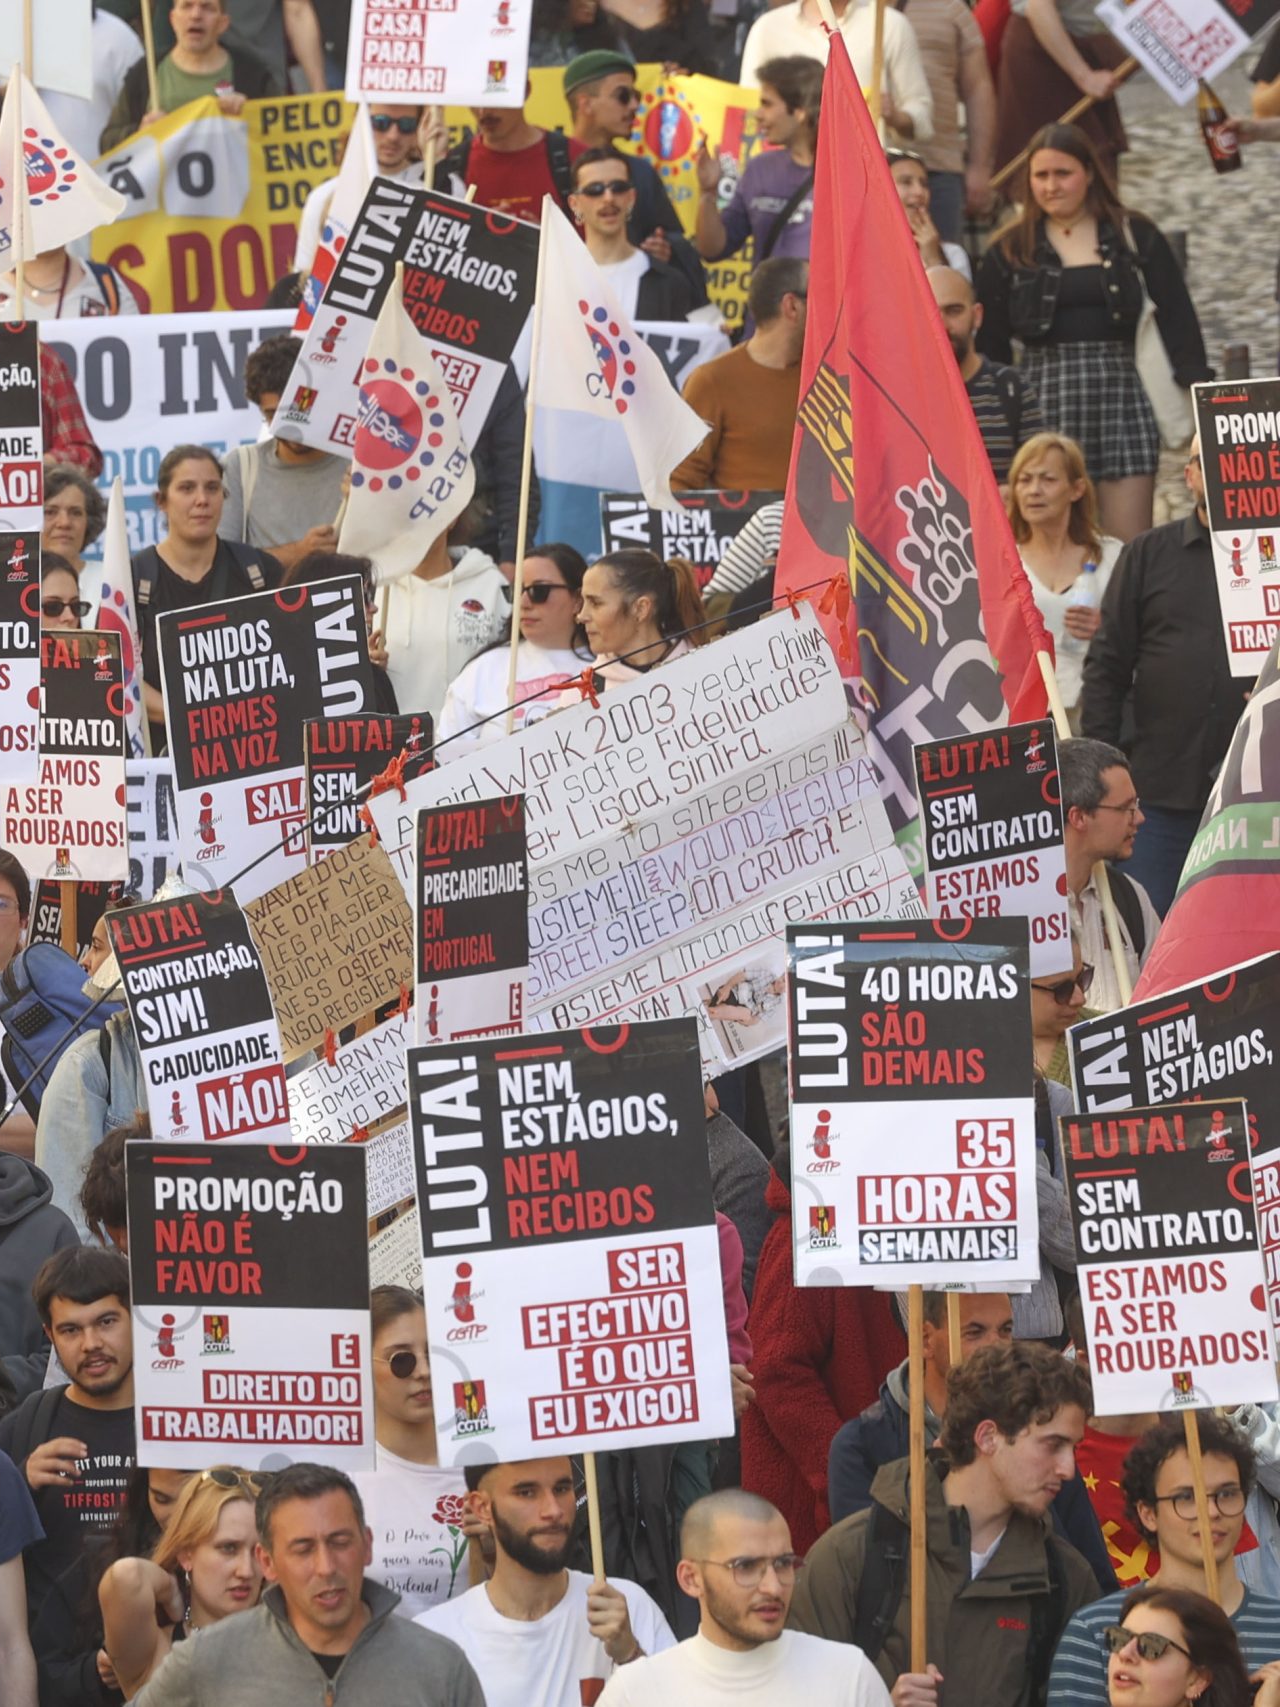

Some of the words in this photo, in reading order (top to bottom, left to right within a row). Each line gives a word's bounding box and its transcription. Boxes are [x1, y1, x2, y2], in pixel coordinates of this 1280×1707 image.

[367, 13, 423, 37] CASA
[365, 41, 420, 64] PARA
[362, 67, 443, 93] MORAR!
[261, 100, 342, 136] PELO
[330, 184, 416, 313] LUTA!
[404, 238, 519, 303] ESTÁGIOS,
[1215, 411, 1280, 445] PROM
[1220, 445, 1265, 483] NÃO
[179, 618, 272, 668] UNIDOS
[183, 668, 221, 705] NA
[225, 653, 296, 697] LUTA,
[187, 693, 278, 743] FIRMES
[311, 719, 394, 754] LUTA!
[191, 742, 229, 779] NA
[231, 730, 280, 770] VOZ
[920, 735, 1011, 783] LUTA!
[6, 788, 19, 814] A
[25, 788, 63, 814] SER
[313, 771, 357, 802] SEM
[6, 818, 125, 848] ROUBADOS!
[425, 808, 486, 855] LUTA!
[930, 793, 978, 829] SEM
[931, 810, 1060, 861] CONTRATO.
[424, 861, 524, 905] PRECARIEDADE
[935, 856, 1040, 902] ESTAMOS
[111, 902, 203, 952] LUTA!
[424, 907, 444, 938] EM
[126, 942, 258, 995] CONTRATAÇÃO,
[424, 934, 496, 973] PORTUGAL
[860, 965, 900, 1003] 40
[908, 963, 1019, 1002] HORAS
[136, 987, 209, 1043] SIM!
[795, 934, 849, 1088] LUTA!
[860, 1004, 927, 1047] SÃO
[148, 1033, 278, 1086] CADUCIDADE,
[1141, 1014, 1199, 1067] NEM
[497, 1060, 573, 1107] NEM
[862, 1048, 987, 1087] DEMAIS
[1145, 1028, 1274, 1105] ESTÁGIOS,
[203, 1073, 286, 1136] NÃO!
[500, 1092, 678, 1150] ESTÁGIOS,
[417, 1054, 493, 1249] LUTA!
[961, 1120, 1012, 1168] 35
[1068, 1114, 1187, 1161] LUTA!
[503, 1149, 580, 1196] NEM
[806, 1160, 841, 1174] CGTP
[153, 1171, 343, 1221] PROMOÇÃO
[506, 1183, 656, 1239] RECIBOS
[863, 1174, 1013, 1225] HORAS
[1077, 1178, 1141, 1216] SEM
[154, 1212, 226, 1255] NÃO
[233, 1212, 253, 1255] É
[810, 1237, 837, 1248] CGTP
[862, 1229, 1016, 1263] SEMANAIS!
[1079, 1207, 1254, 1255] CONTRATO.
[156, 1259, 262, 1295] FAVOR
[617, 1246, 682, 1289] SER
[1086, 1259, 1228, 1302] ESTAMOS
[446, 1323, 488, 1343] CGTP
[527, 1291, 687, 1345] EFECTIVO
[1093, 1306, 1115, 1338] A
[1120, 1300, 1177, 1336] SER
[337, 1336, 355, 1366] É
[565, 1342, 585, 1387] É
[592, 1345, 617, 1382] O
[623, 1337, 689, 1384] QUE
[1093, 1329, 1270, 1376] ROUBADOS!
[208, 1373, 315, 1402] DIREITO
[321, 1375, 358, 1403] DO
[535, 1396, 577, 1436] EU
[583, 1382, 695, 1433] EXIGO!
[146, 1410, 359, 1442] TRABALHADOR!
[456, 1419, 491, 1436] CGTP
[94, 1454, 122, 1469] YOUR
